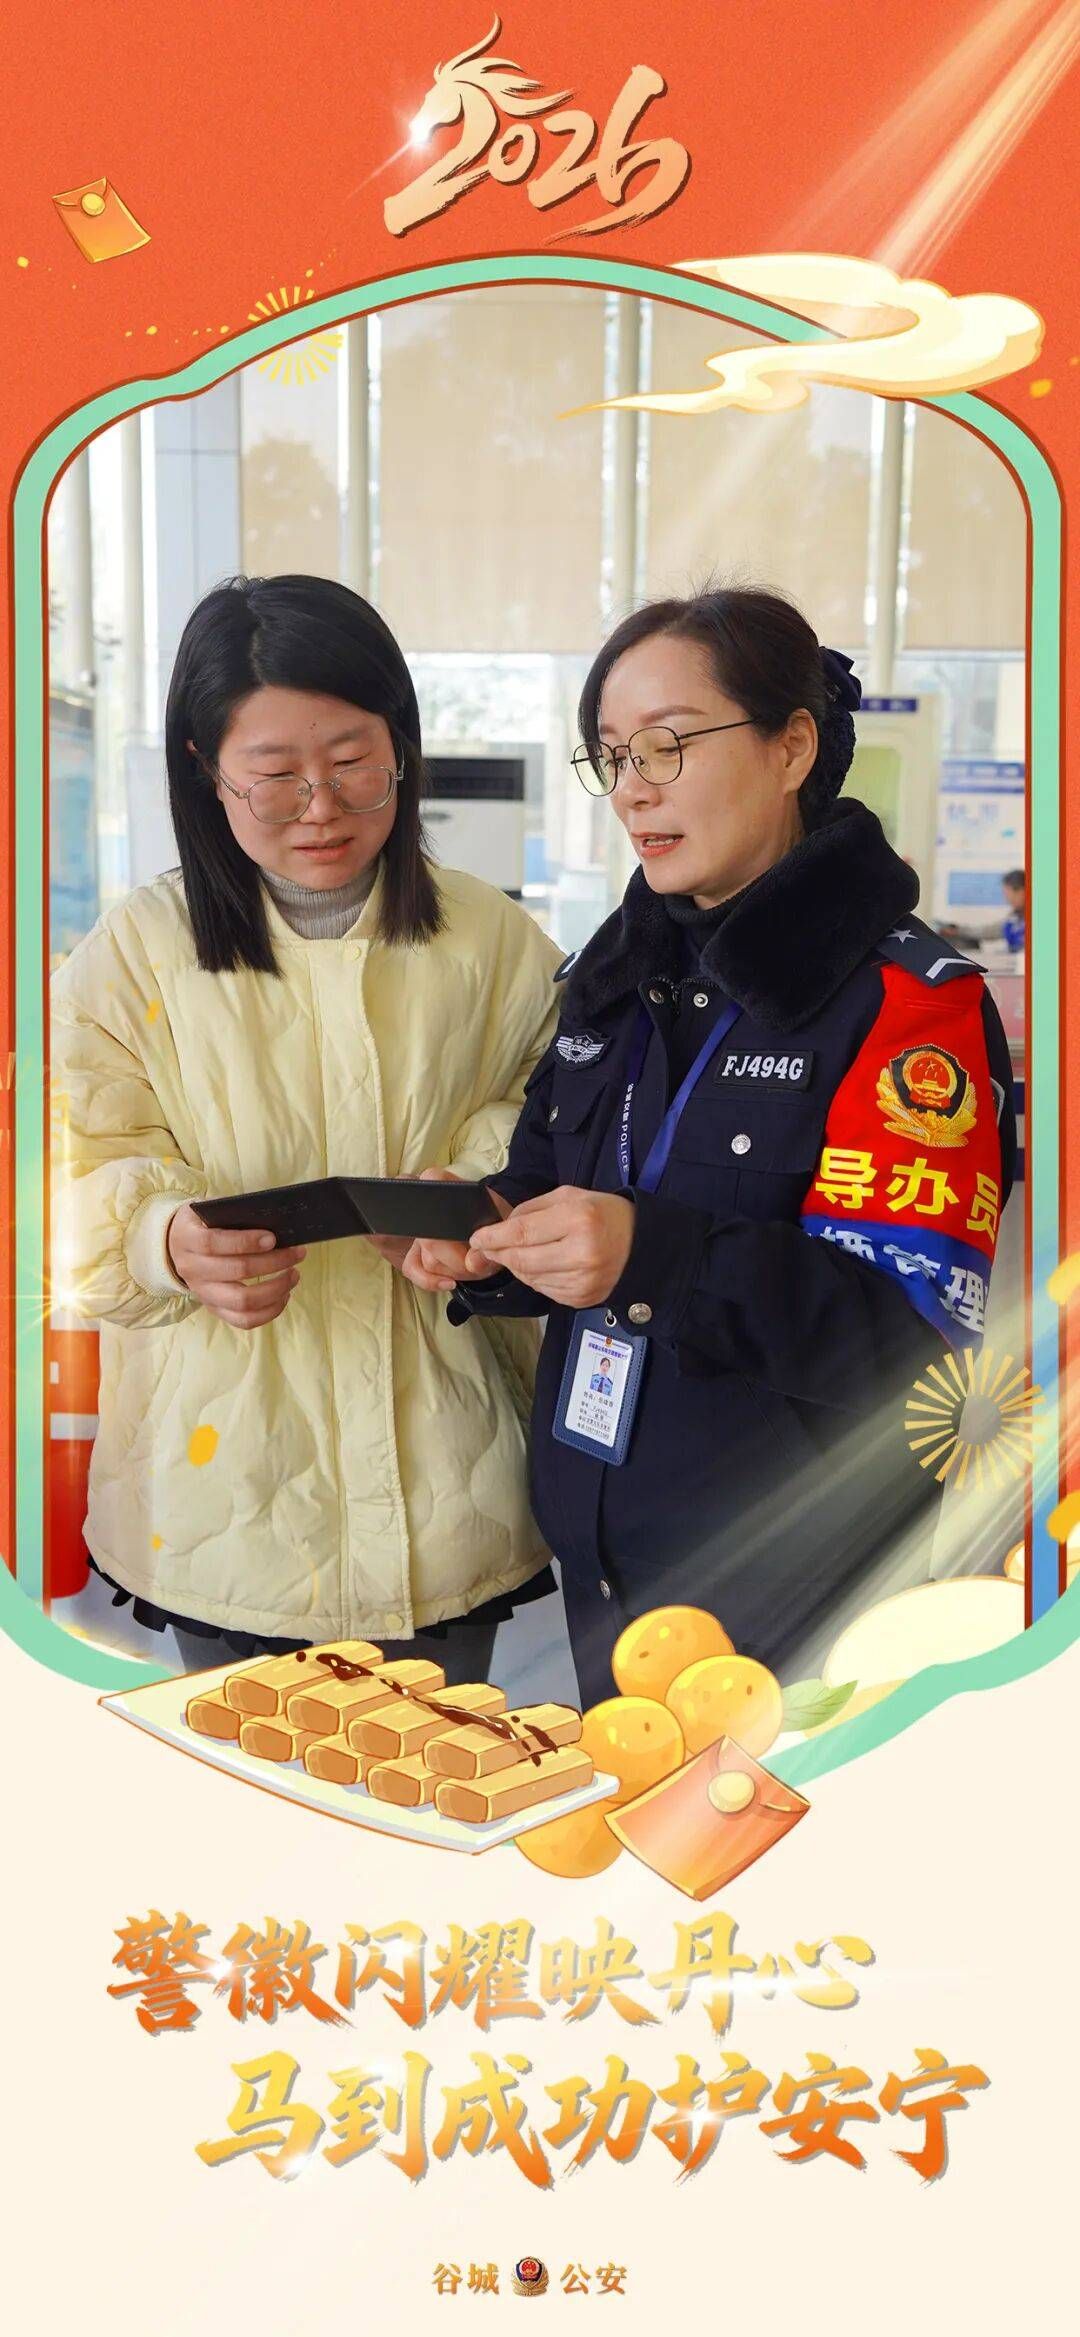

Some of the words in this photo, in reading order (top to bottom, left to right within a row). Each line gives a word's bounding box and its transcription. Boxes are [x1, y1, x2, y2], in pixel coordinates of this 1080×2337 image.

[721, 1056, 804, 1080] FJ494G
[620, 1124, 630, 1173] POLICE
[815, 1146, 999, 1246] 导办员
